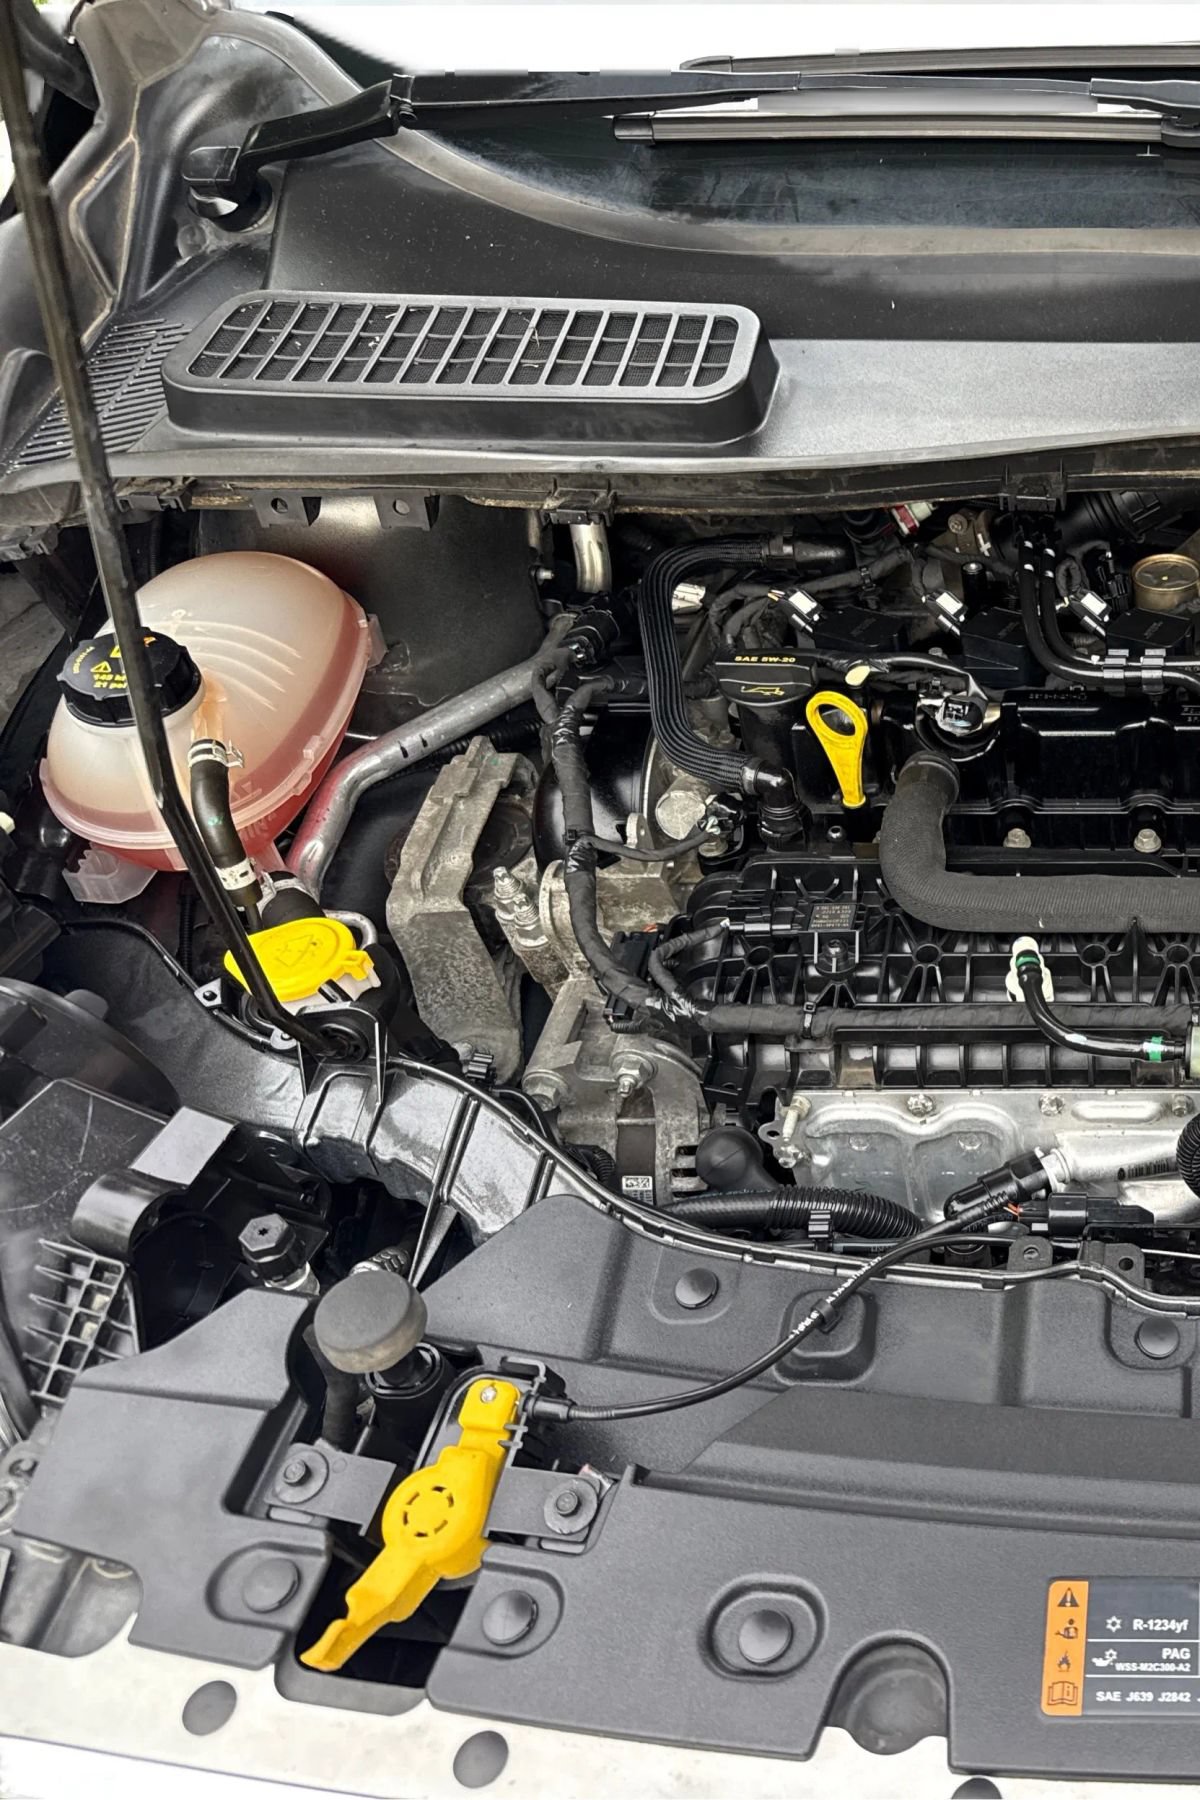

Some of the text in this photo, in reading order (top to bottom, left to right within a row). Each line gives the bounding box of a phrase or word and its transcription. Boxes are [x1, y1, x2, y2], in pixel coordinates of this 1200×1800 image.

[734, 655, 759, 663] SAE
[1132, 1618, 1189, 1634] R-1234yf
[1161, 1647, 1191, 1660] PAG
[1115, 1662, 1191, 1672] WSS-M2C300-A2
[1095, 1691, 1122, 1702] SAE
[1125, 1691, 1154, 1702] J639
[1157, 1692, 1192, 1702] J2842
